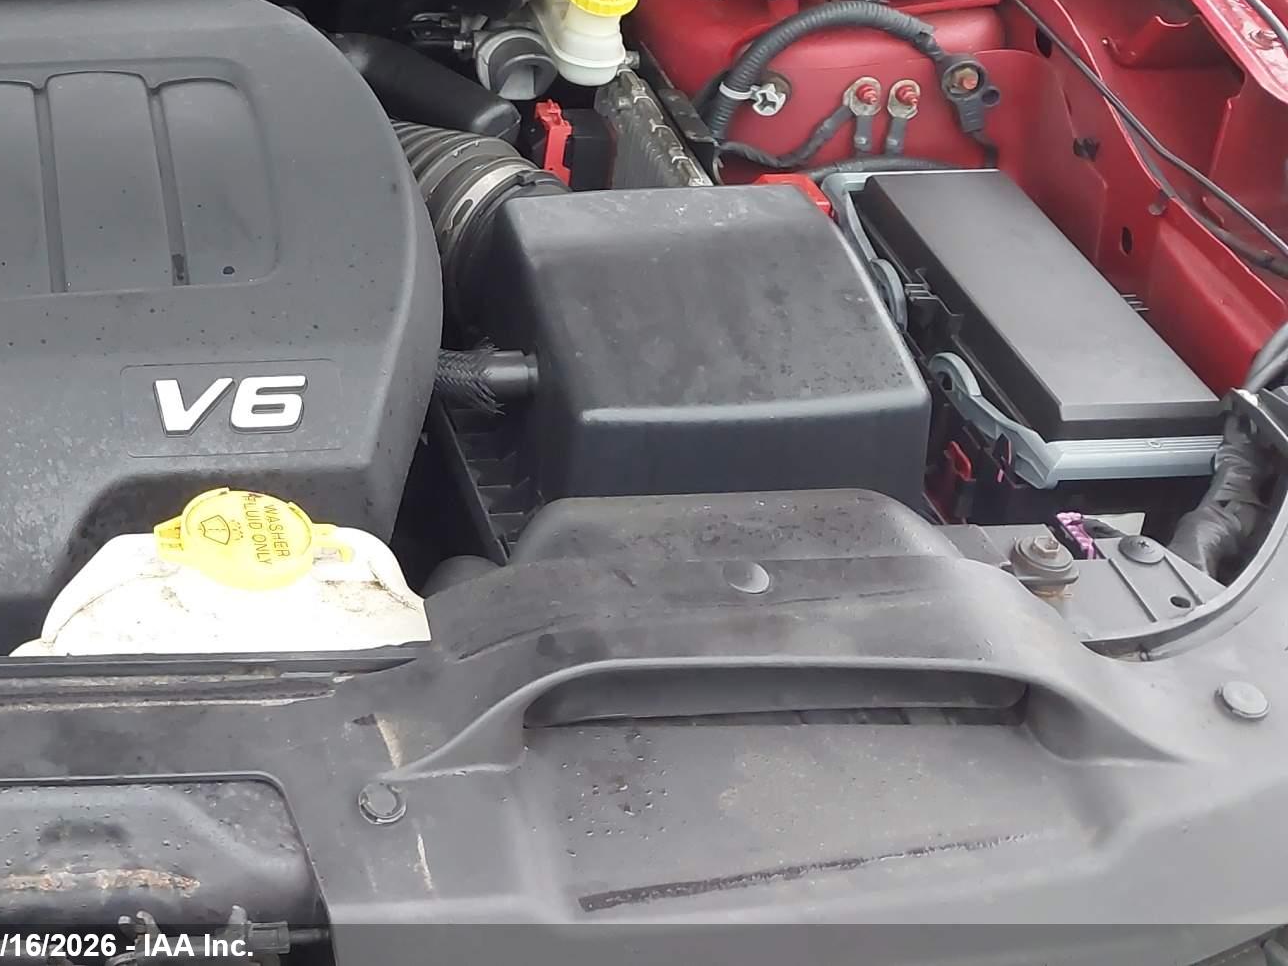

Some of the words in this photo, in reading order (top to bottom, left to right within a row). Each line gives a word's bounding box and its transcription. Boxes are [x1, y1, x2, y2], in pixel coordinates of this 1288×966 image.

[153, 375, 307, 436] V6
[241, 493, 263, 530] FLUID
[264, 504, 291, 558] WASHER
[251, 534, 272, 565] ONLY
